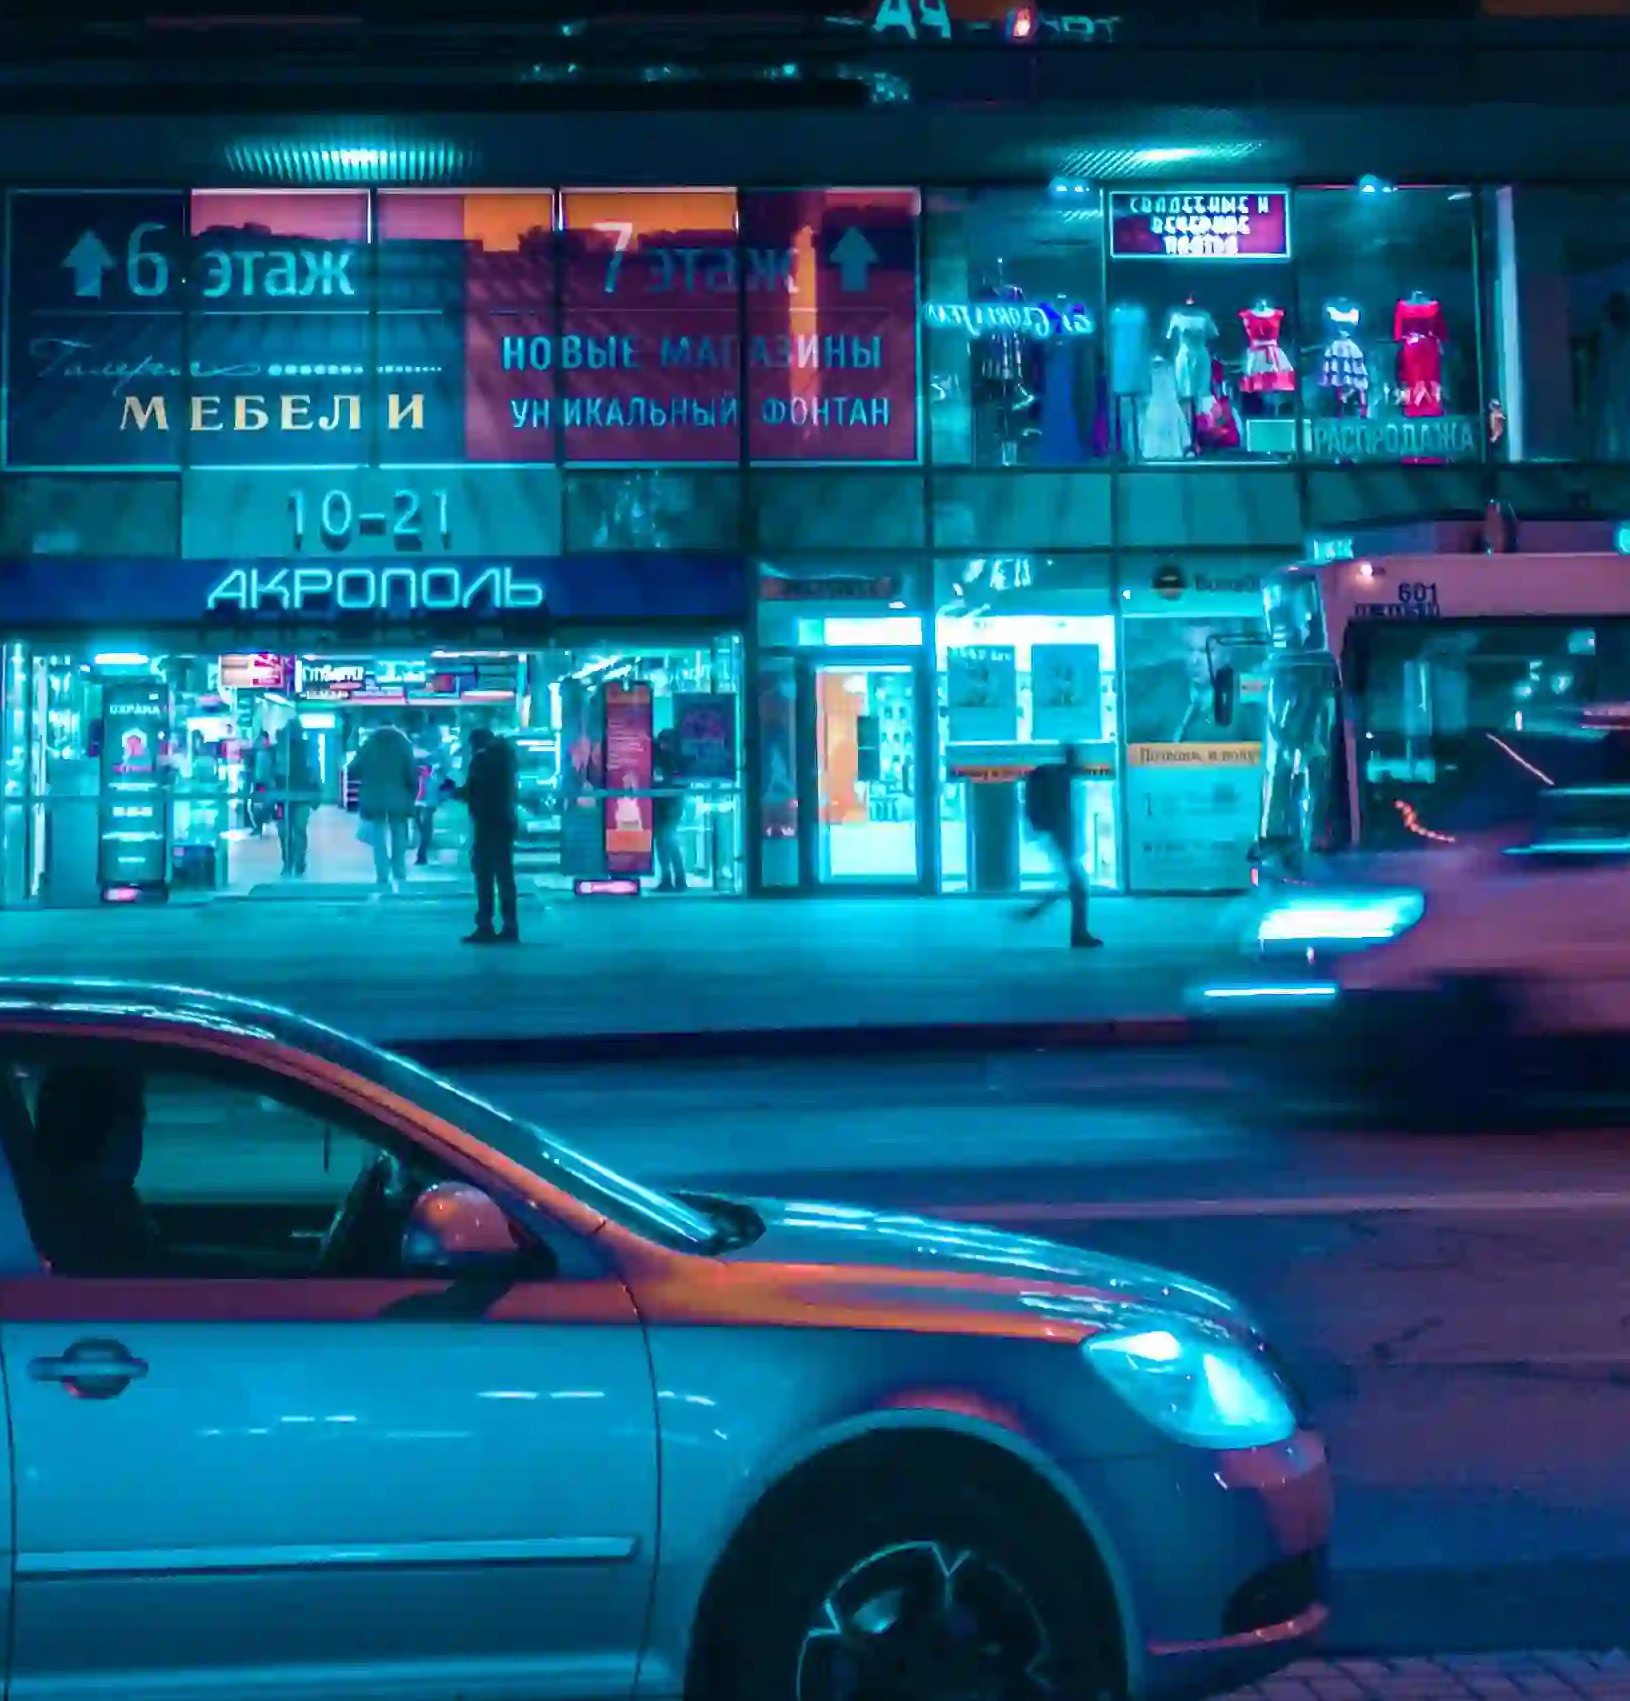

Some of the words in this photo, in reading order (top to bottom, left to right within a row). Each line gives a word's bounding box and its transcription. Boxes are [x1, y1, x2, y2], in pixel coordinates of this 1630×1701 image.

[126, 221, 169, 297] 6
[202, 248, 357, 297] этаж
[592, 221, 634, 293] 7
[646, 247, 800, 293] этаж
[501, 333, 639, 371] НОВЫЕ
[659, 332, 884, 370] МАГАЗИНЫ
[118, 393, 426, 431] МЕБЕЛИ
[510, 395, 740, 429] УНИКАЛЬНЫЙ
[761, 395, 891, 428] ФОНТАН
[288, 488, 450, 536] 10-21
[205, 566, 546, 611] АКРОПОЛЬ
[1397, 581, 1438, 603] 601
